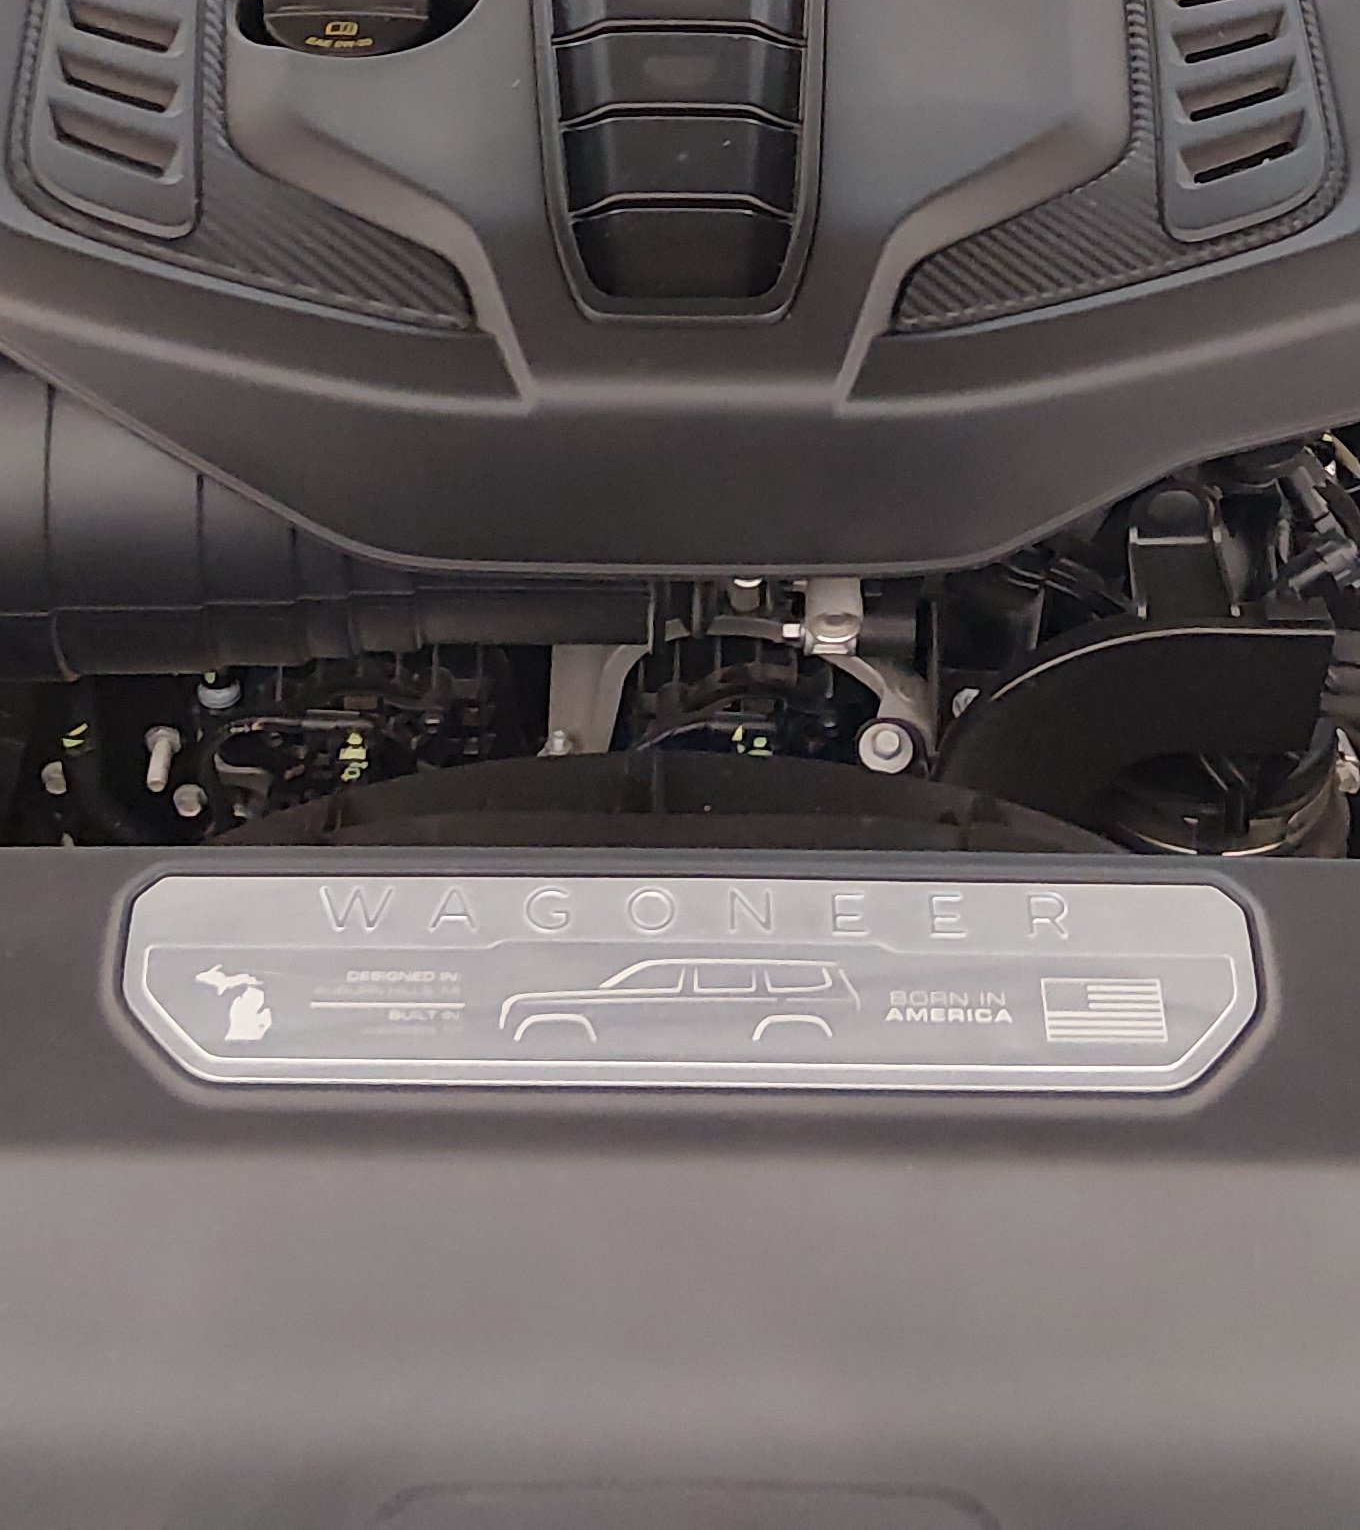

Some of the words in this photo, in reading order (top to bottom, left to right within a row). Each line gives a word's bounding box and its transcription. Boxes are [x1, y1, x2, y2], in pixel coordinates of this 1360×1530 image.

[318, 884, 1070, 940] WAGONEER
[346, 969, 436, 982] DESIGNED
[439, 970, 459, 982] IN
[889, 989, 969, 1007] BORN
[979, 990, 1007, 1007] IN
[884, 1007, 1014, 1024] AMERICA
